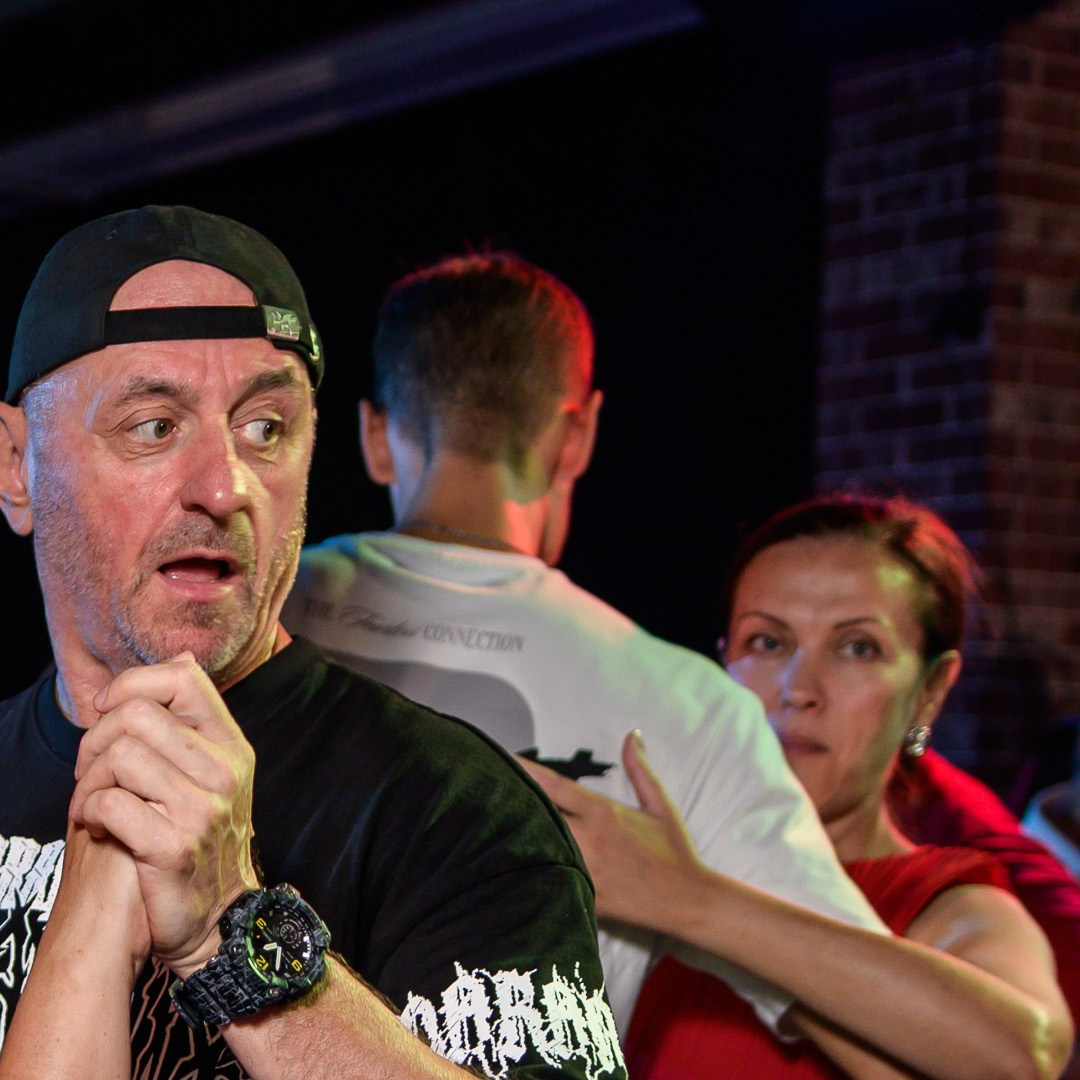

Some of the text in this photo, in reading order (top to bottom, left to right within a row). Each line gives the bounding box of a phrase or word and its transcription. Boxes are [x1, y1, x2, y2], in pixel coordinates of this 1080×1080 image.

[423, 622, 526, 652] CONNECTION
[255, 917, 267, 930] 3
[255, 954, 270, 971] 12
